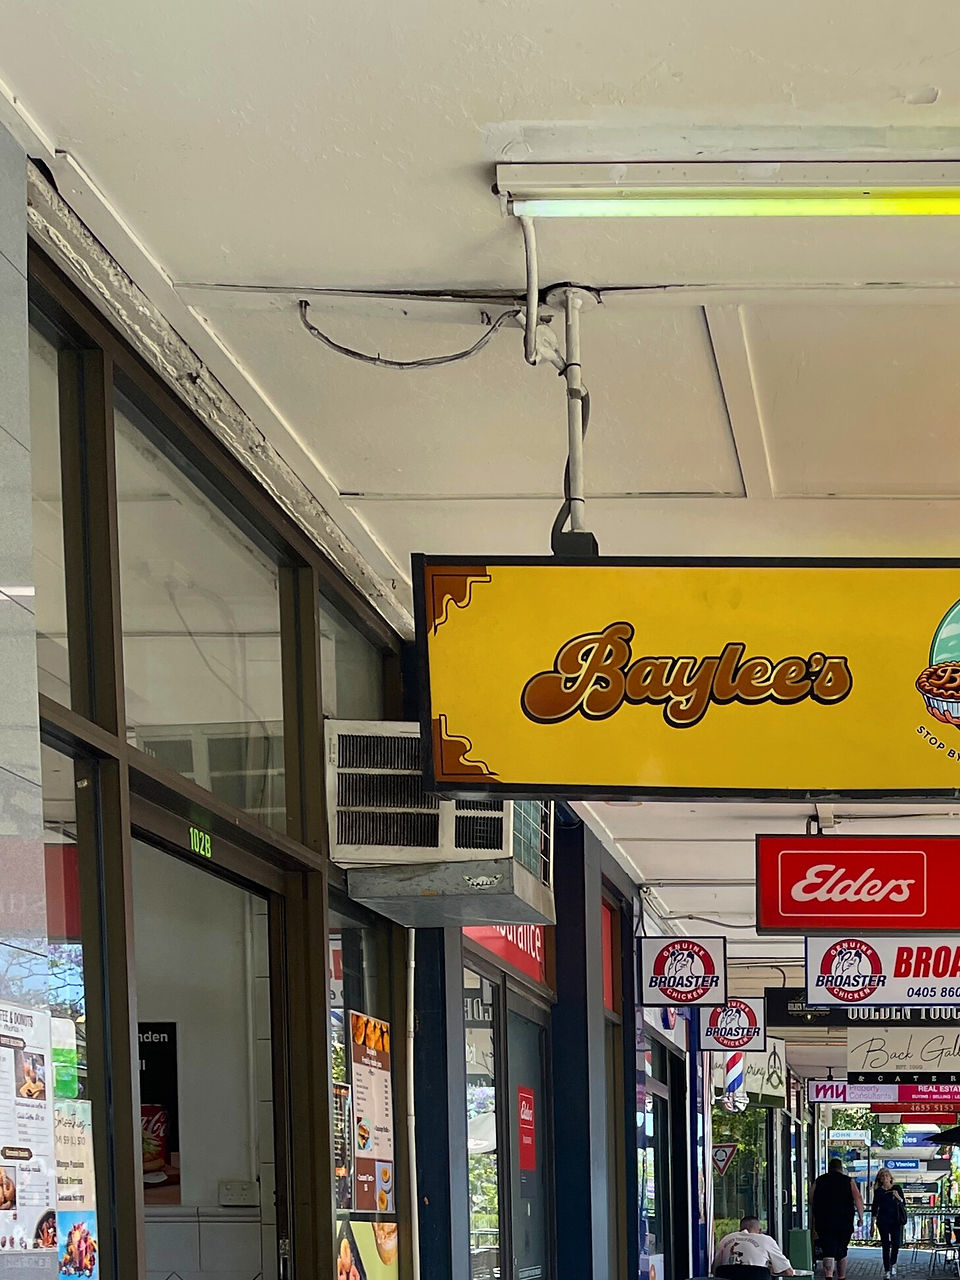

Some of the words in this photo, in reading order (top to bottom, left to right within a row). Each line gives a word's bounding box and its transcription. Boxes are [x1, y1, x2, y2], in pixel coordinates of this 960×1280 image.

[521, 622, 853, 729] Baylee's
[916, 725, 945, 751] STOP
[190, 827, 211, 857] 102B
[791, 864, 916, 903] Elders
[663, 943, 704, 957] GENUINE
[831, 942, 872, 955] GENUINE
[649, 975, 720, 988] BROASTER
[815, 975, 887, 987] BROASTER
[666, 988, 704, 1000] CHICKEN
[833, 987, 870, 1000] CHICKEN
[906, 986, 937, 998] 0405
[705, 1026, 761, 1037] BROASTER
[719, 1036, 749, 1047] CHICKEN
[850, 1034, 914, 1070] Back
[815, 1084, 847, 1102] my
